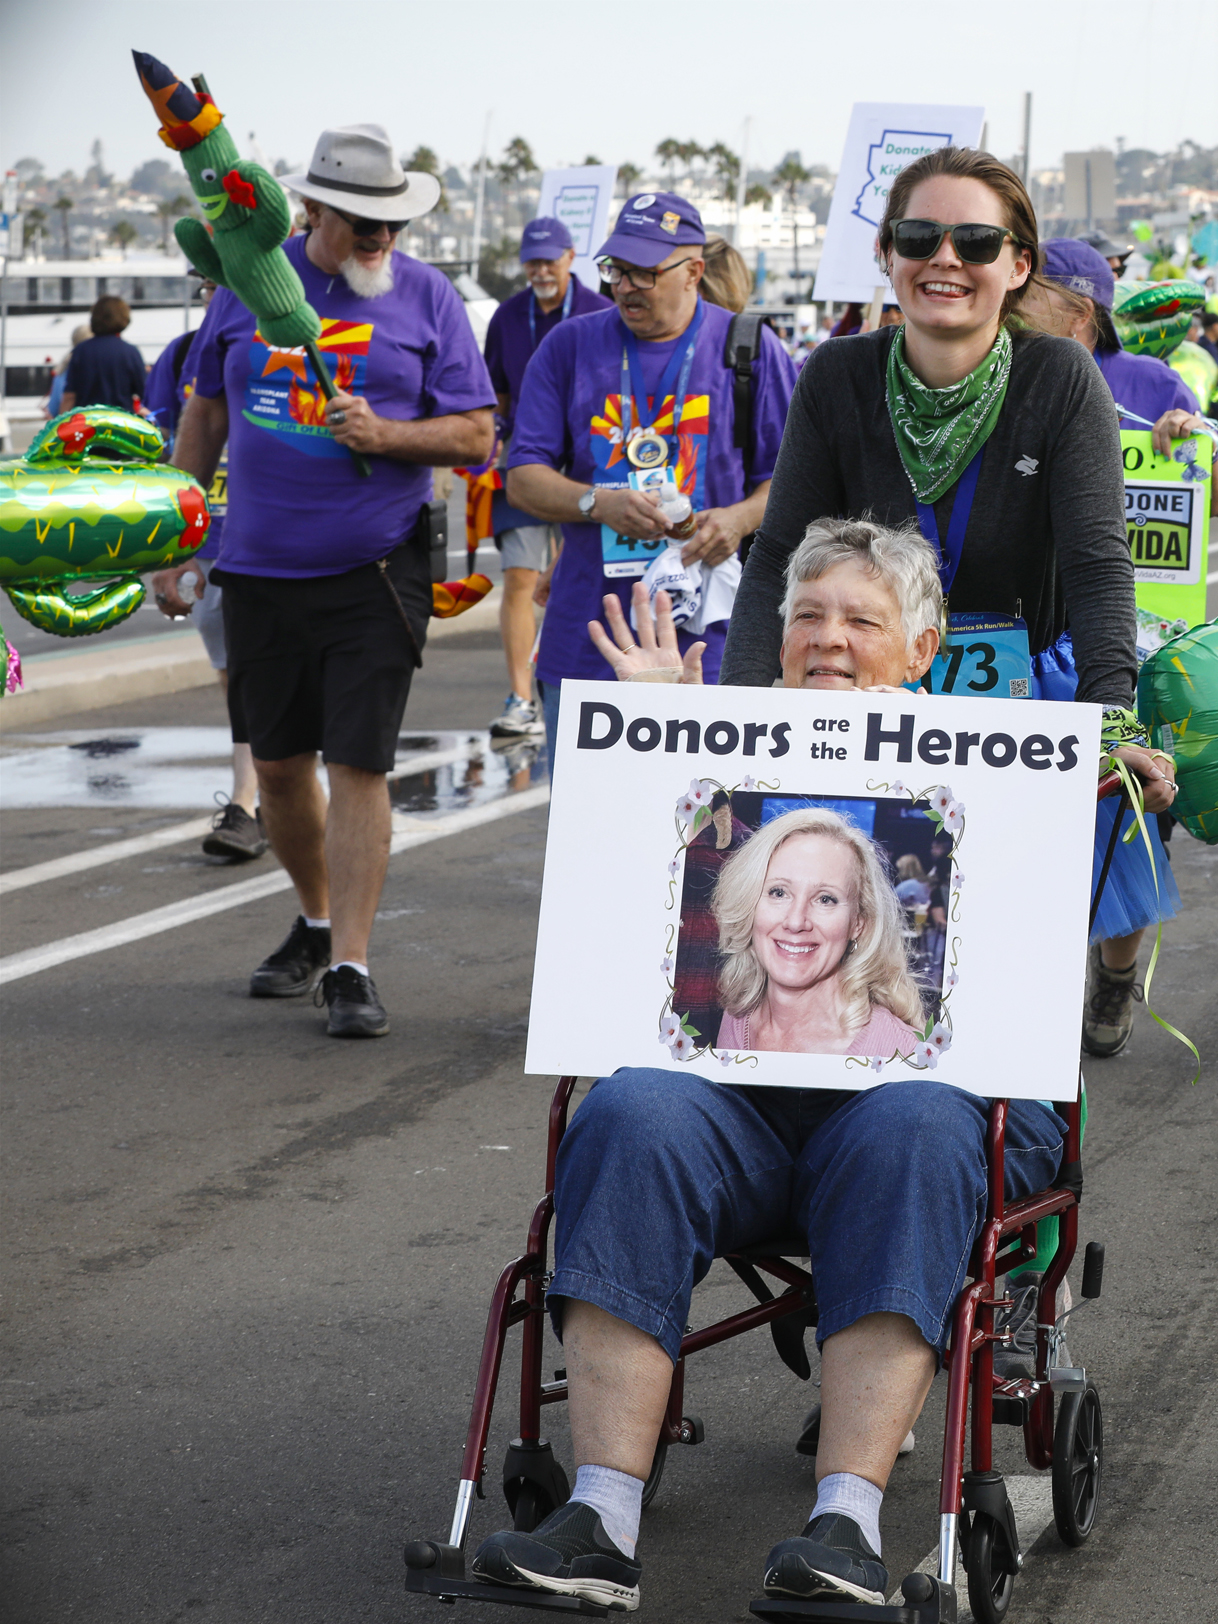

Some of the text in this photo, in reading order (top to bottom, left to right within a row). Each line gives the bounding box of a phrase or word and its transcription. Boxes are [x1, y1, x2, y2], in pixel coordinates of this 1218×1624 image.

[576, 701, 1080, 772] Donors are the Heroes
